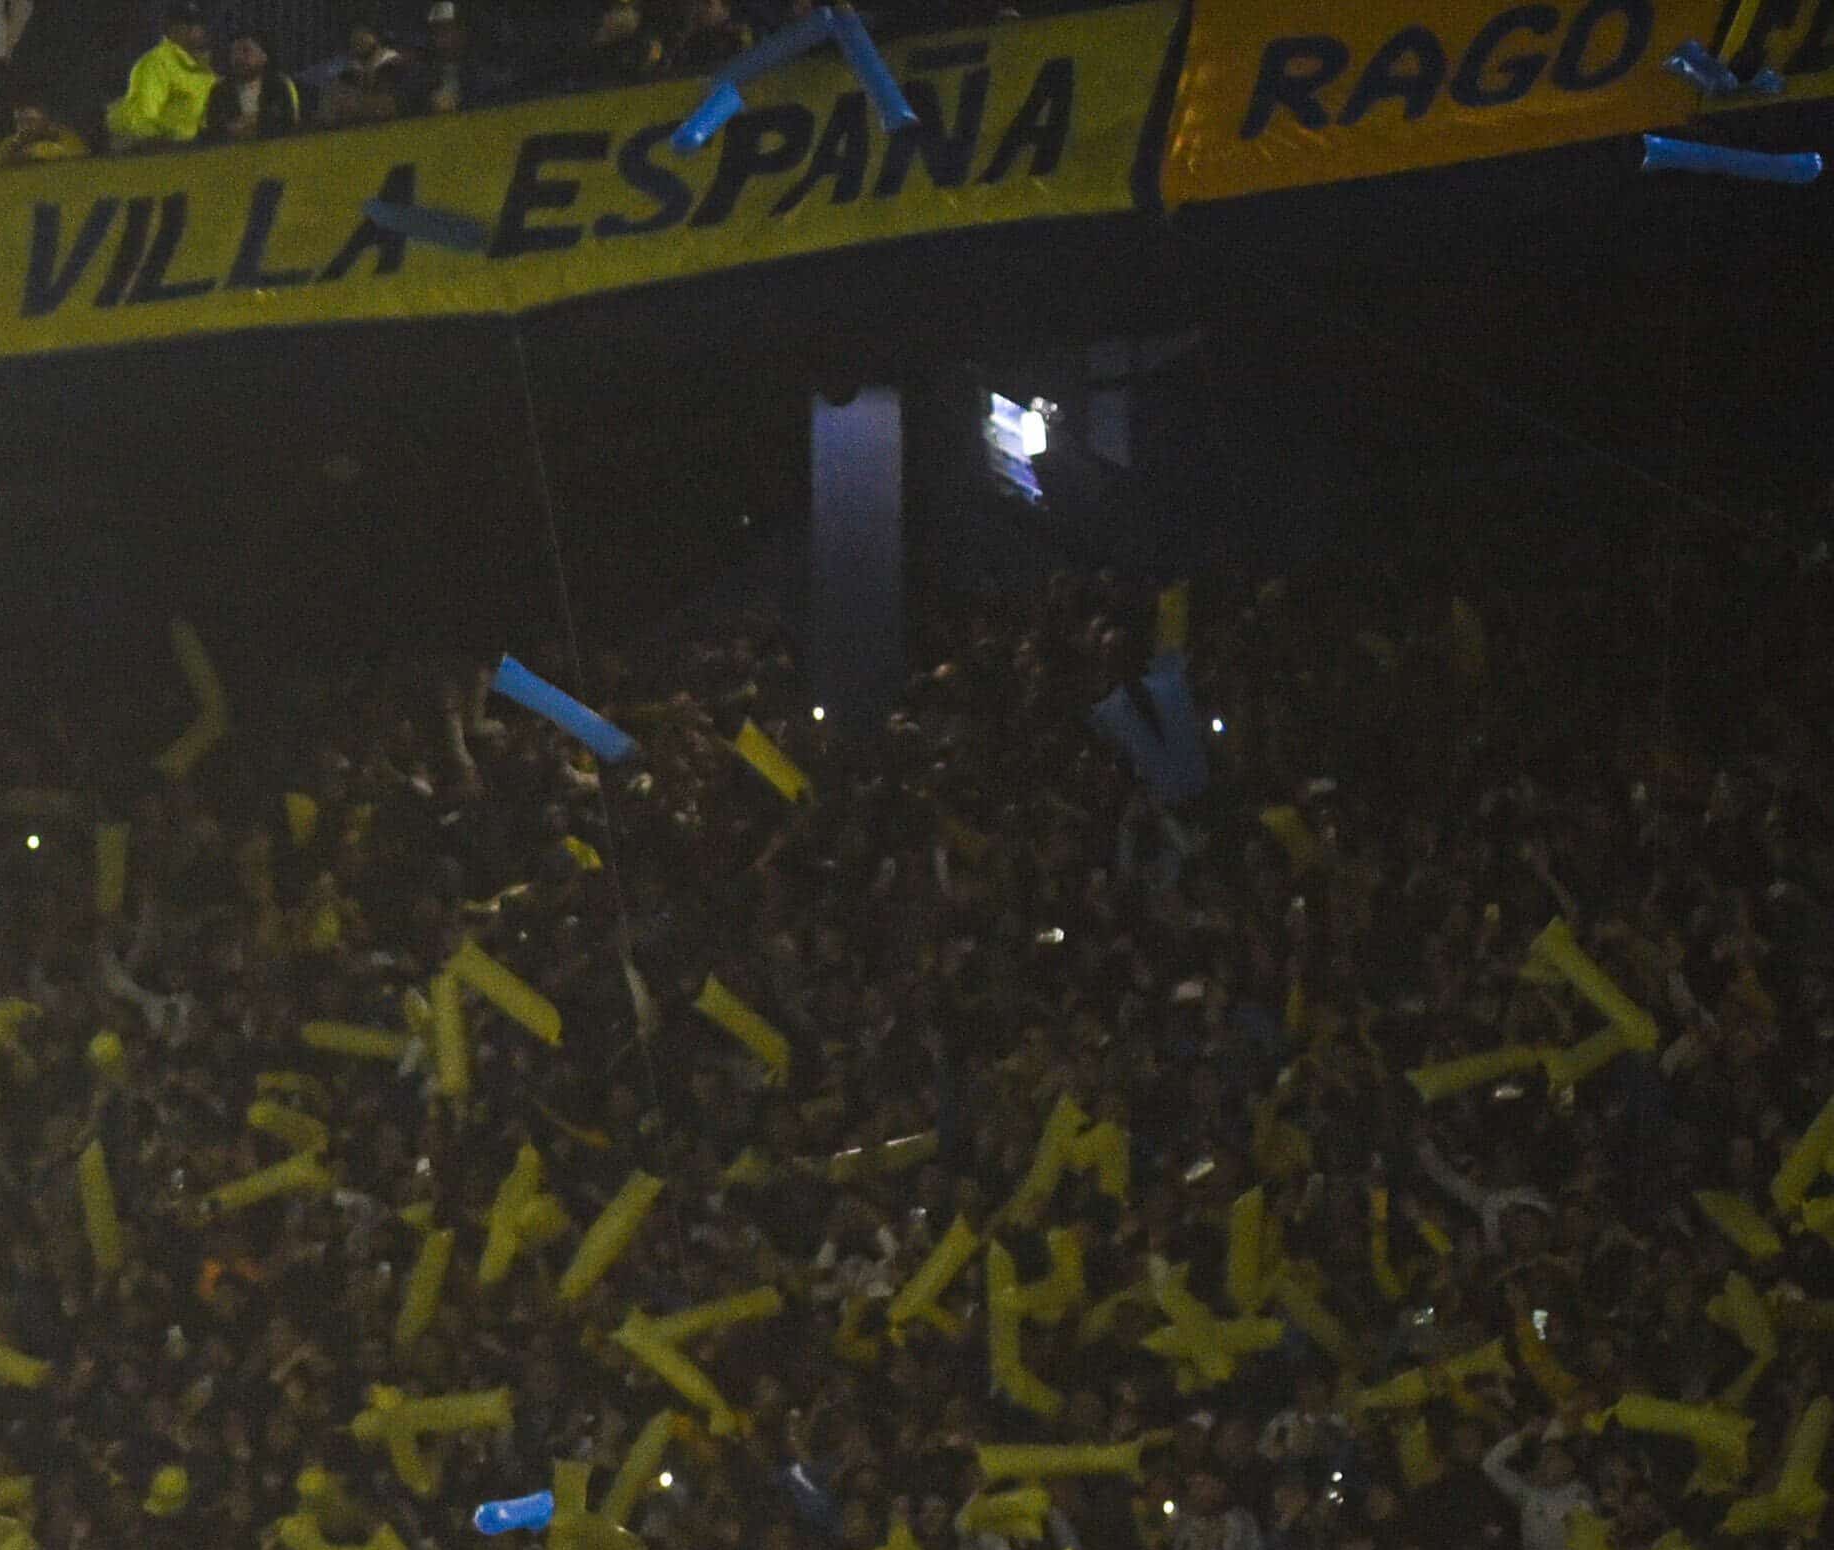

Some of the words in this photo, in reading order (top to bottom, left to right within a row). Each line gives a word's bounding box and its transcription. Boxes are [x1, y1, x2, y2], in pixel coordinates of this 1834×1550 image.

[1239, 0, 1656, 140] RAGO
[19, 164, 418, 322] VILLA
[486, 42, 1077, 260] ESPAÑA
